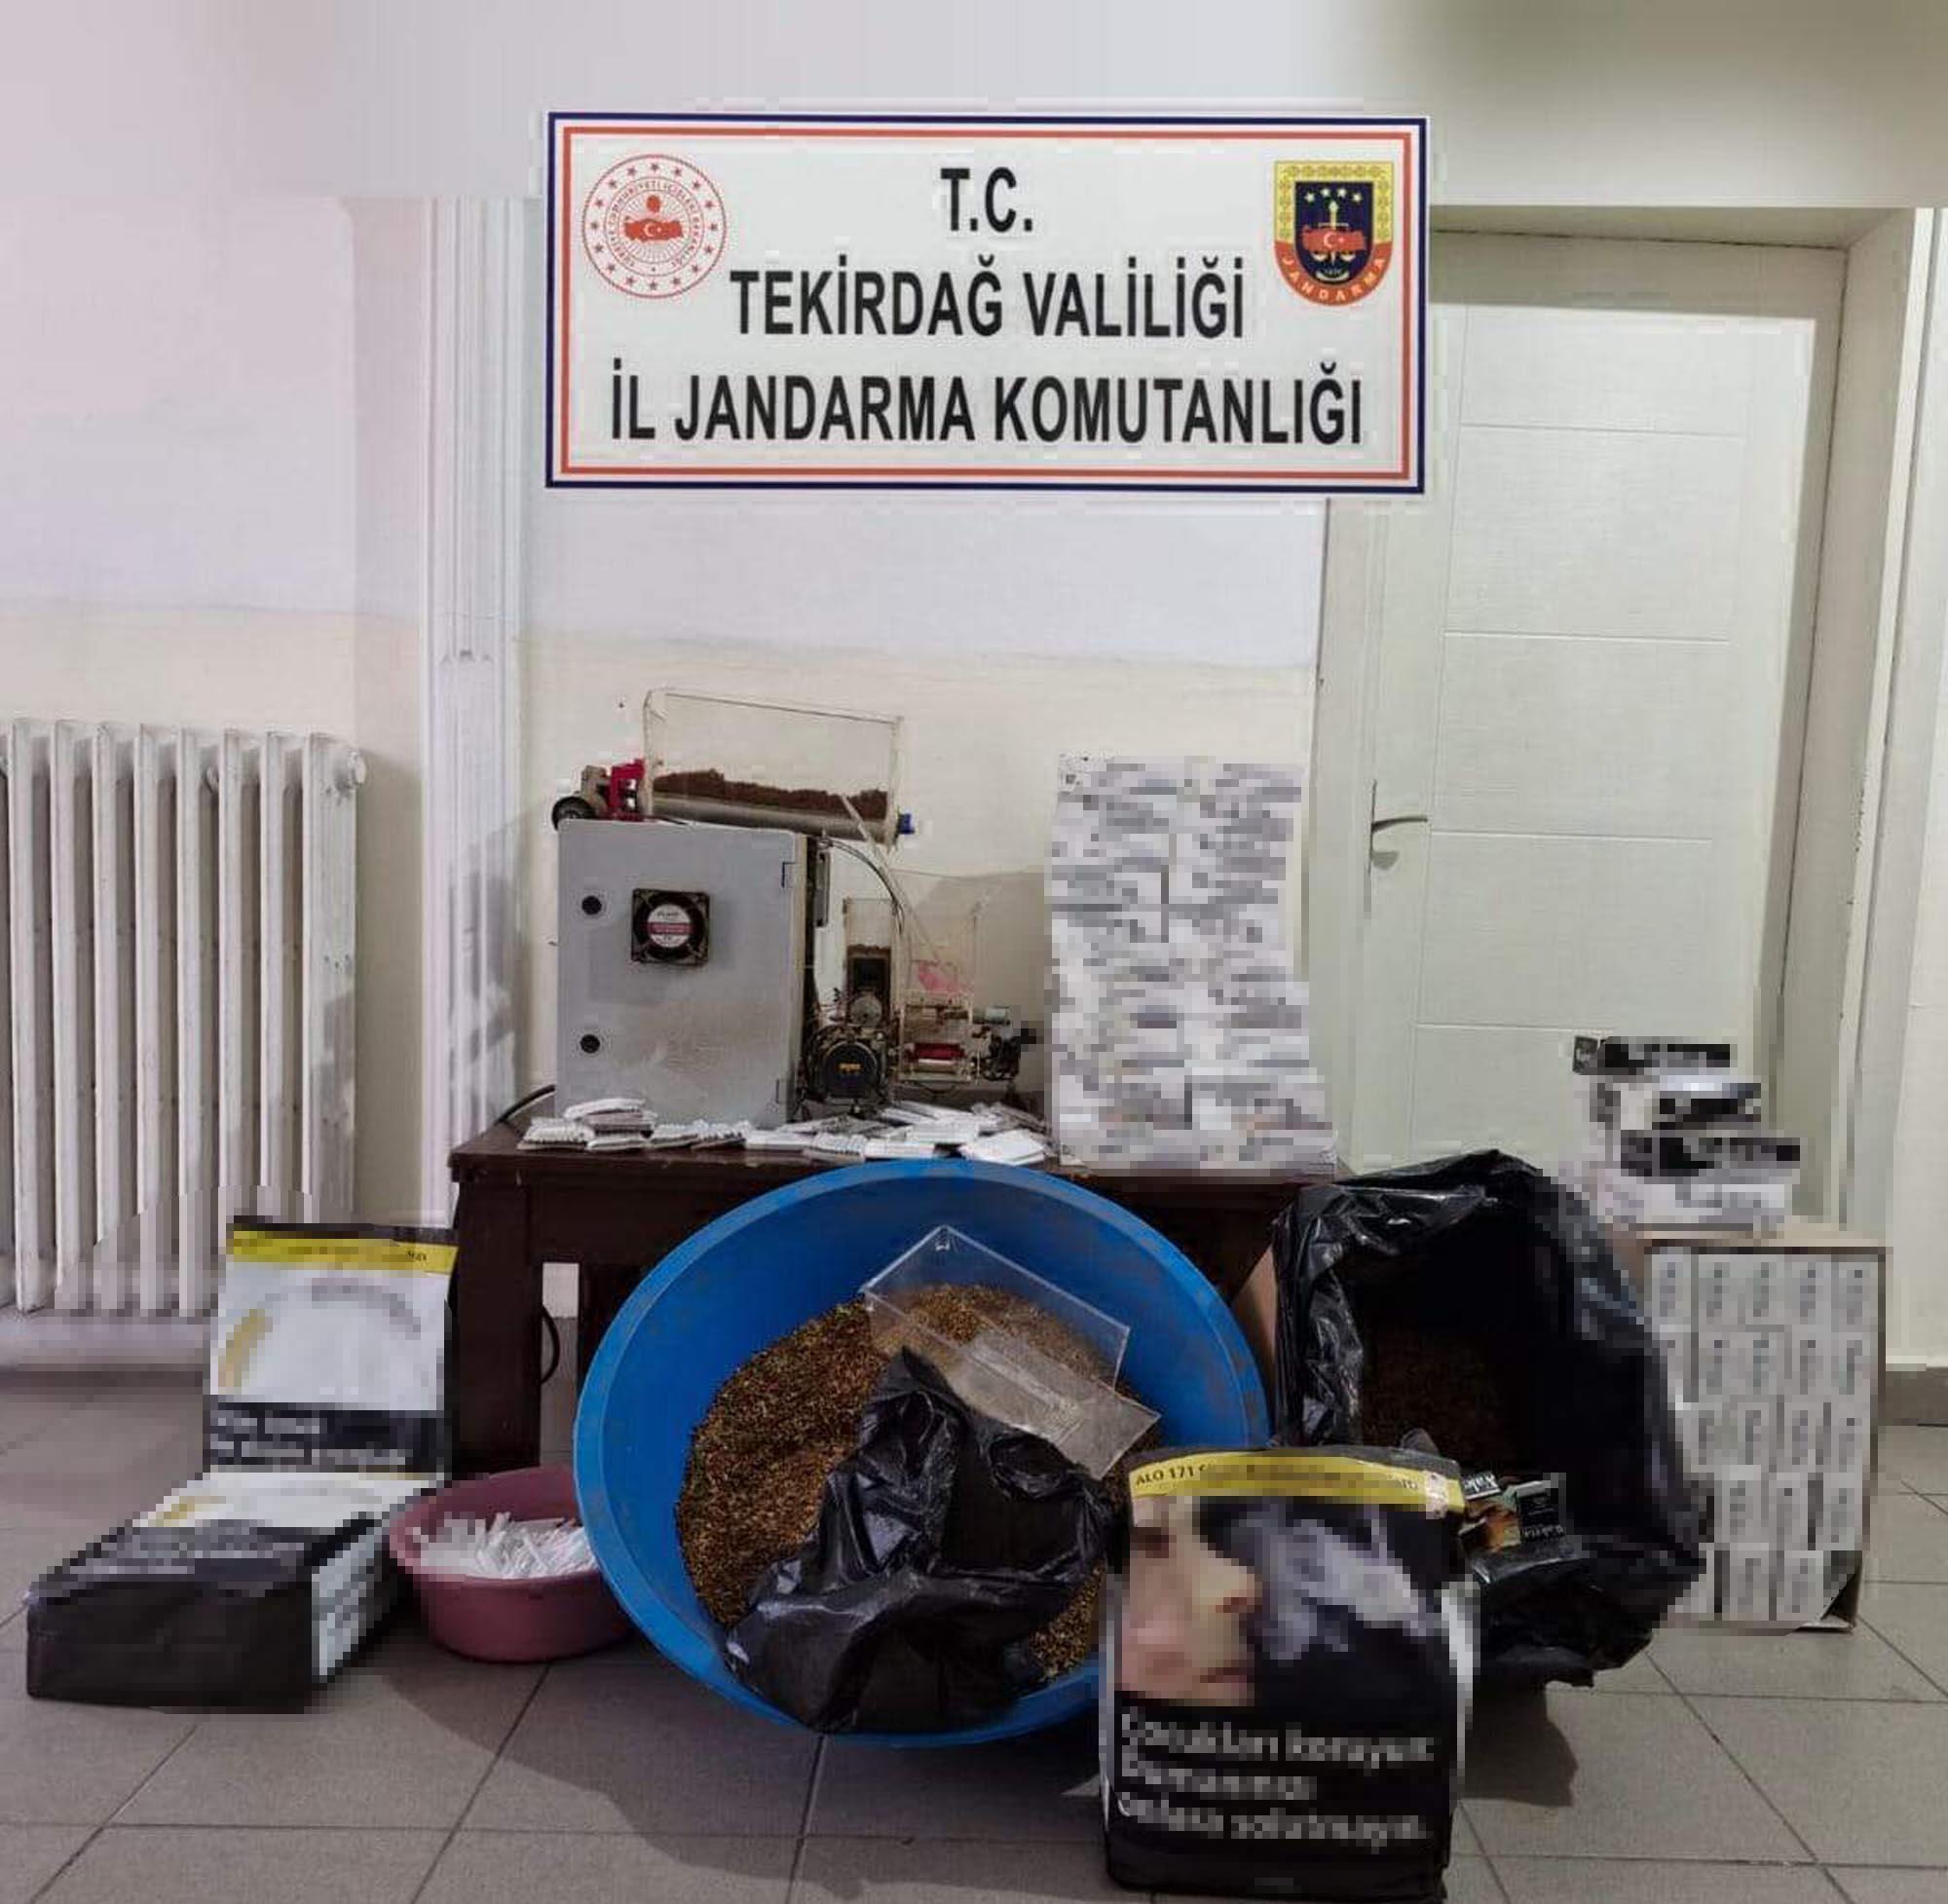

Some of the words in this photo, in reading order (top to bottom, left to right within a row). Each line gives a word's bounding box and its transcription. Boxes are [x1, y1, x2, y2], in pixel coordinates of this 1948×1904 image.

[940, 167, 1032, 233] T.C.
[730, 254, 1002, 337] TEKİRDAĞ
[1023, 256, 1243, 339] VALİLİĞİ
[1282, 258, 1384, 301] JANDARMA
[612, 357, 656, 440] İL
[674, 375, 976, 441] JANDARMA
[994, 361, 1361, 445] KOMUTANLIĞI
[1169, 1465, 1195, 1479] 171
